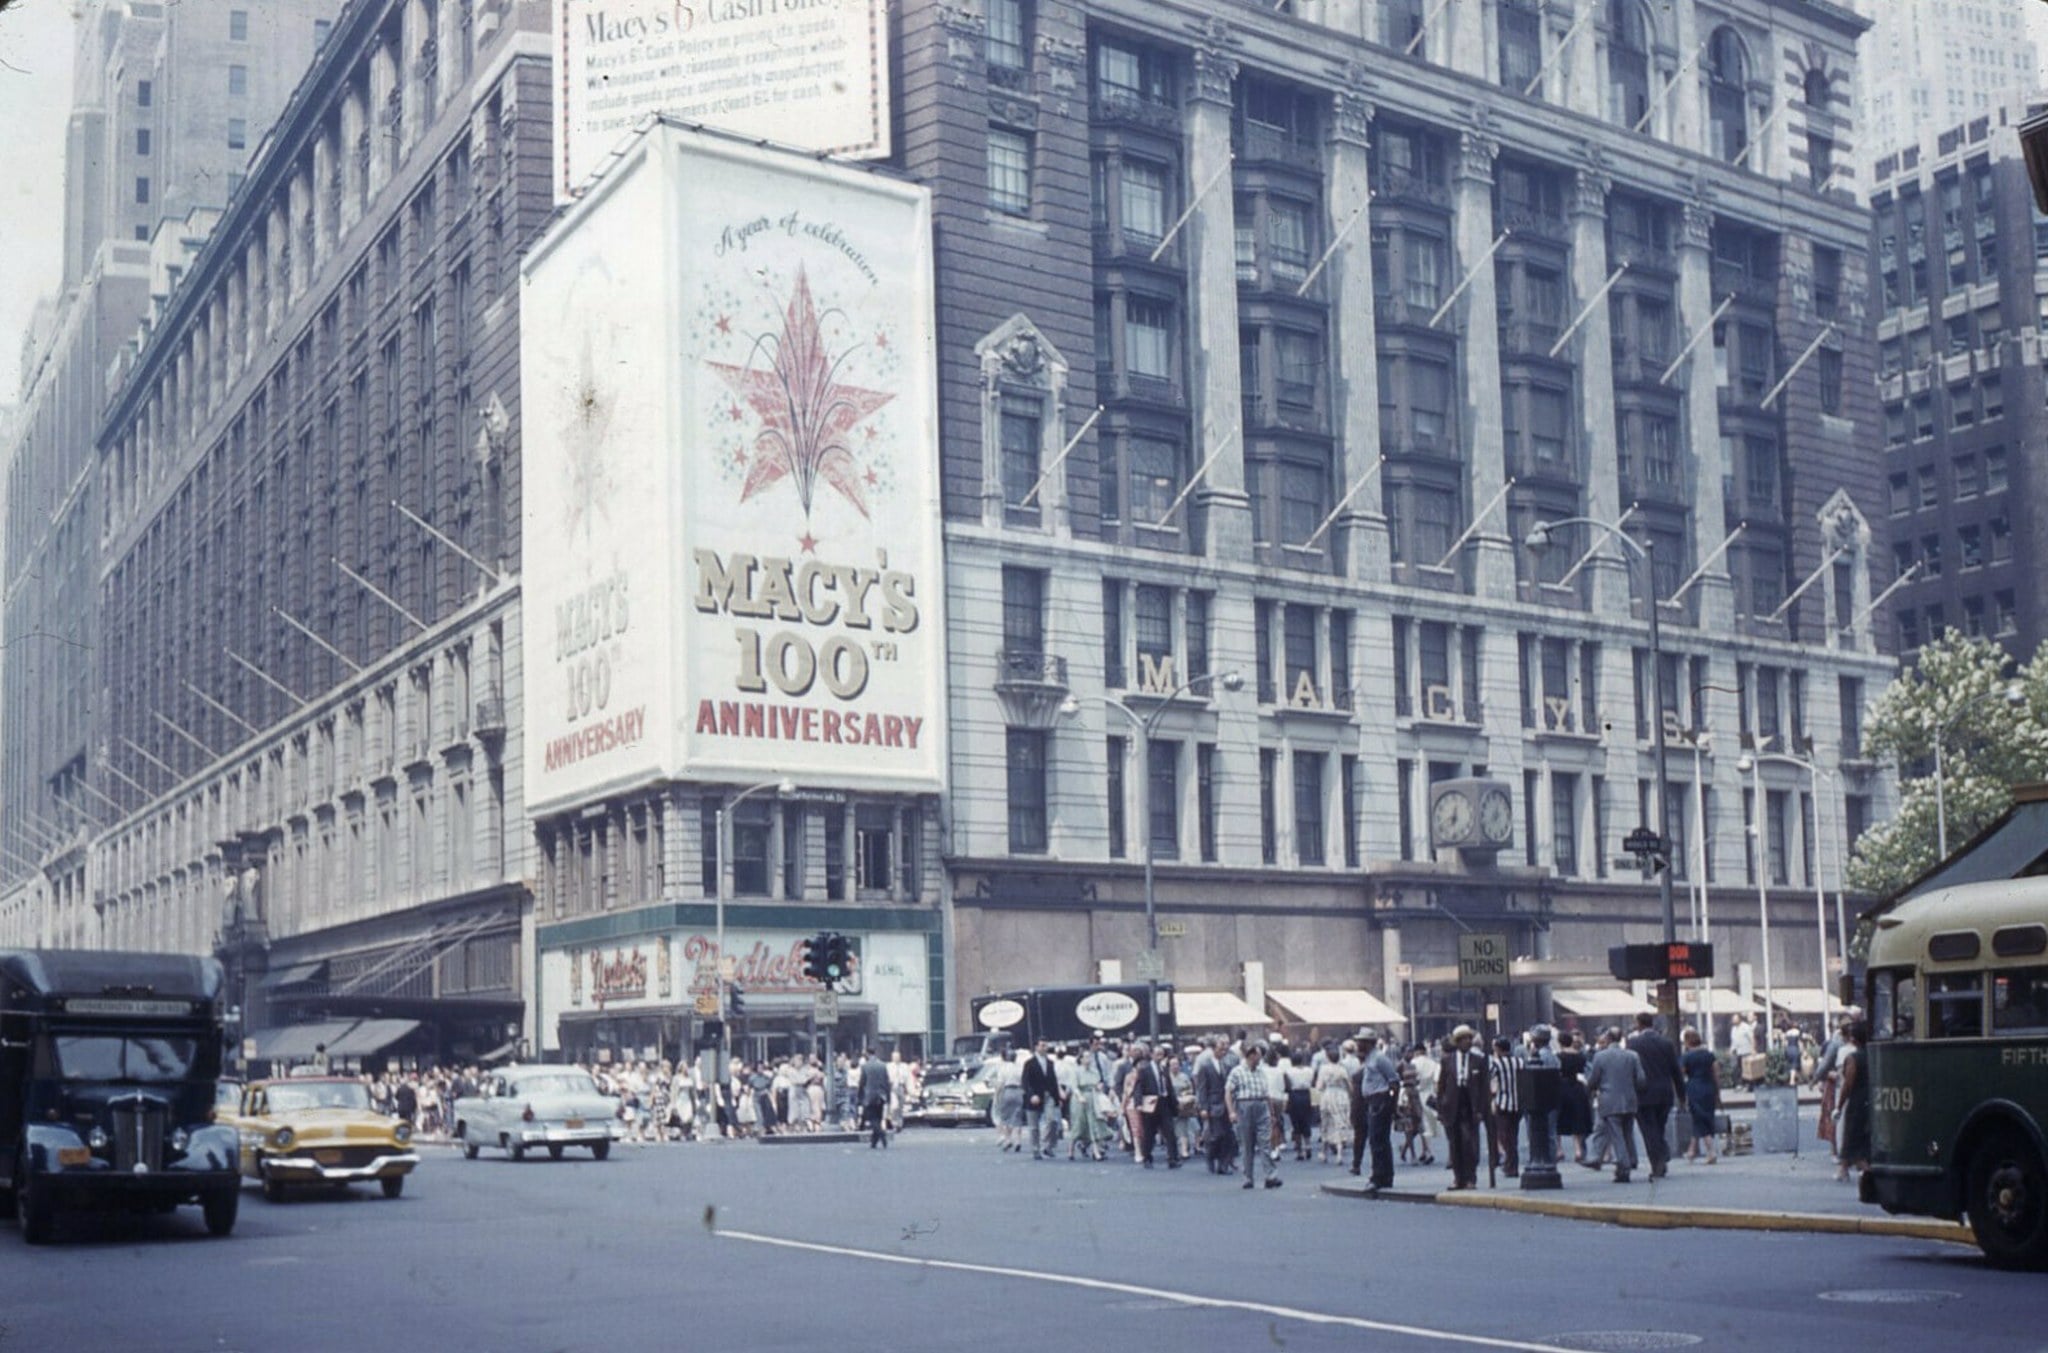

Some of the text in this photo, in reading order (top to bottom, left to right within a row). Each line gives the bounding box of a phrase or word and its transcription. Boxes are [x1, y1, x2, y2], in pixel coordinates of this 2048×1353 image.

[715, 209, 879, 287] A year of celebration
[694, 546, 920, 634] MACY'S
[545, 704, 646, 773] ANNIVERSARY
[696, 699, 923, 750] ANNIVERSARY
[1462, 958, 1504, 975] TURNS
[1473, 940, 1493, 956] NO
[2002, 1048, 2048, 1064] FIFTH
